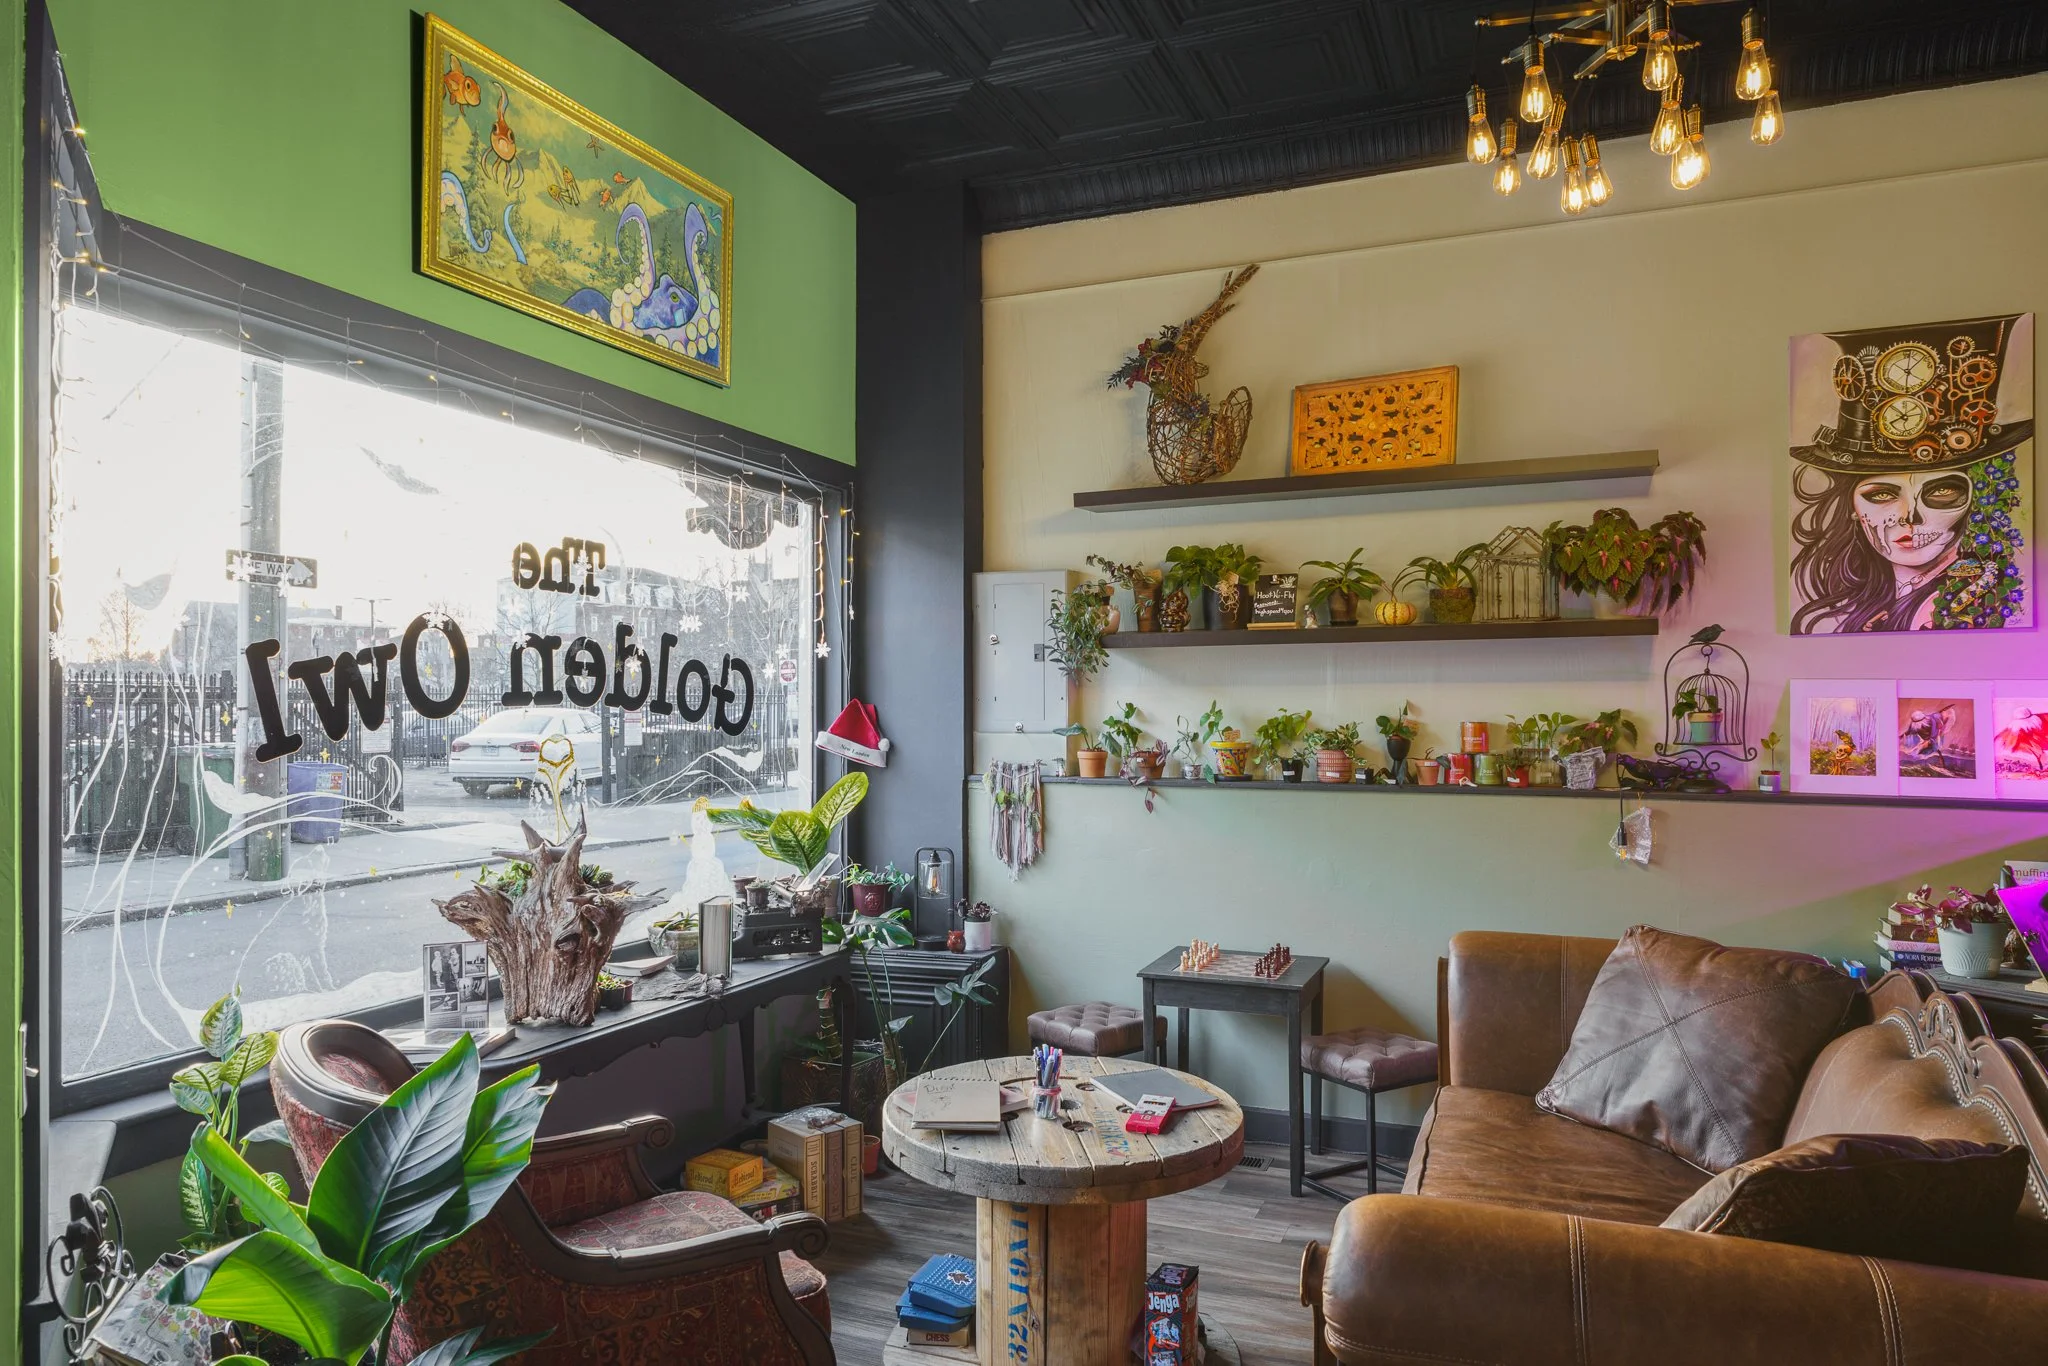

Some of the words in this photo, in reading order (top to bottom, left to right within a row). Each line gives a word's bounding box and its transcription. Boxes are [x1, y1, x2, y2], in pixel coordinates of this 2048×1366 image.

[1904, 953, 1920, 961] NORA
[1140, 1114, 1152, 1122] 18
[810, 1161, 818, 1201] SCRABBLE
[1148, 1292, 1180, 1314] Jenga
[926, 1332, 950, 1343] CHESS
